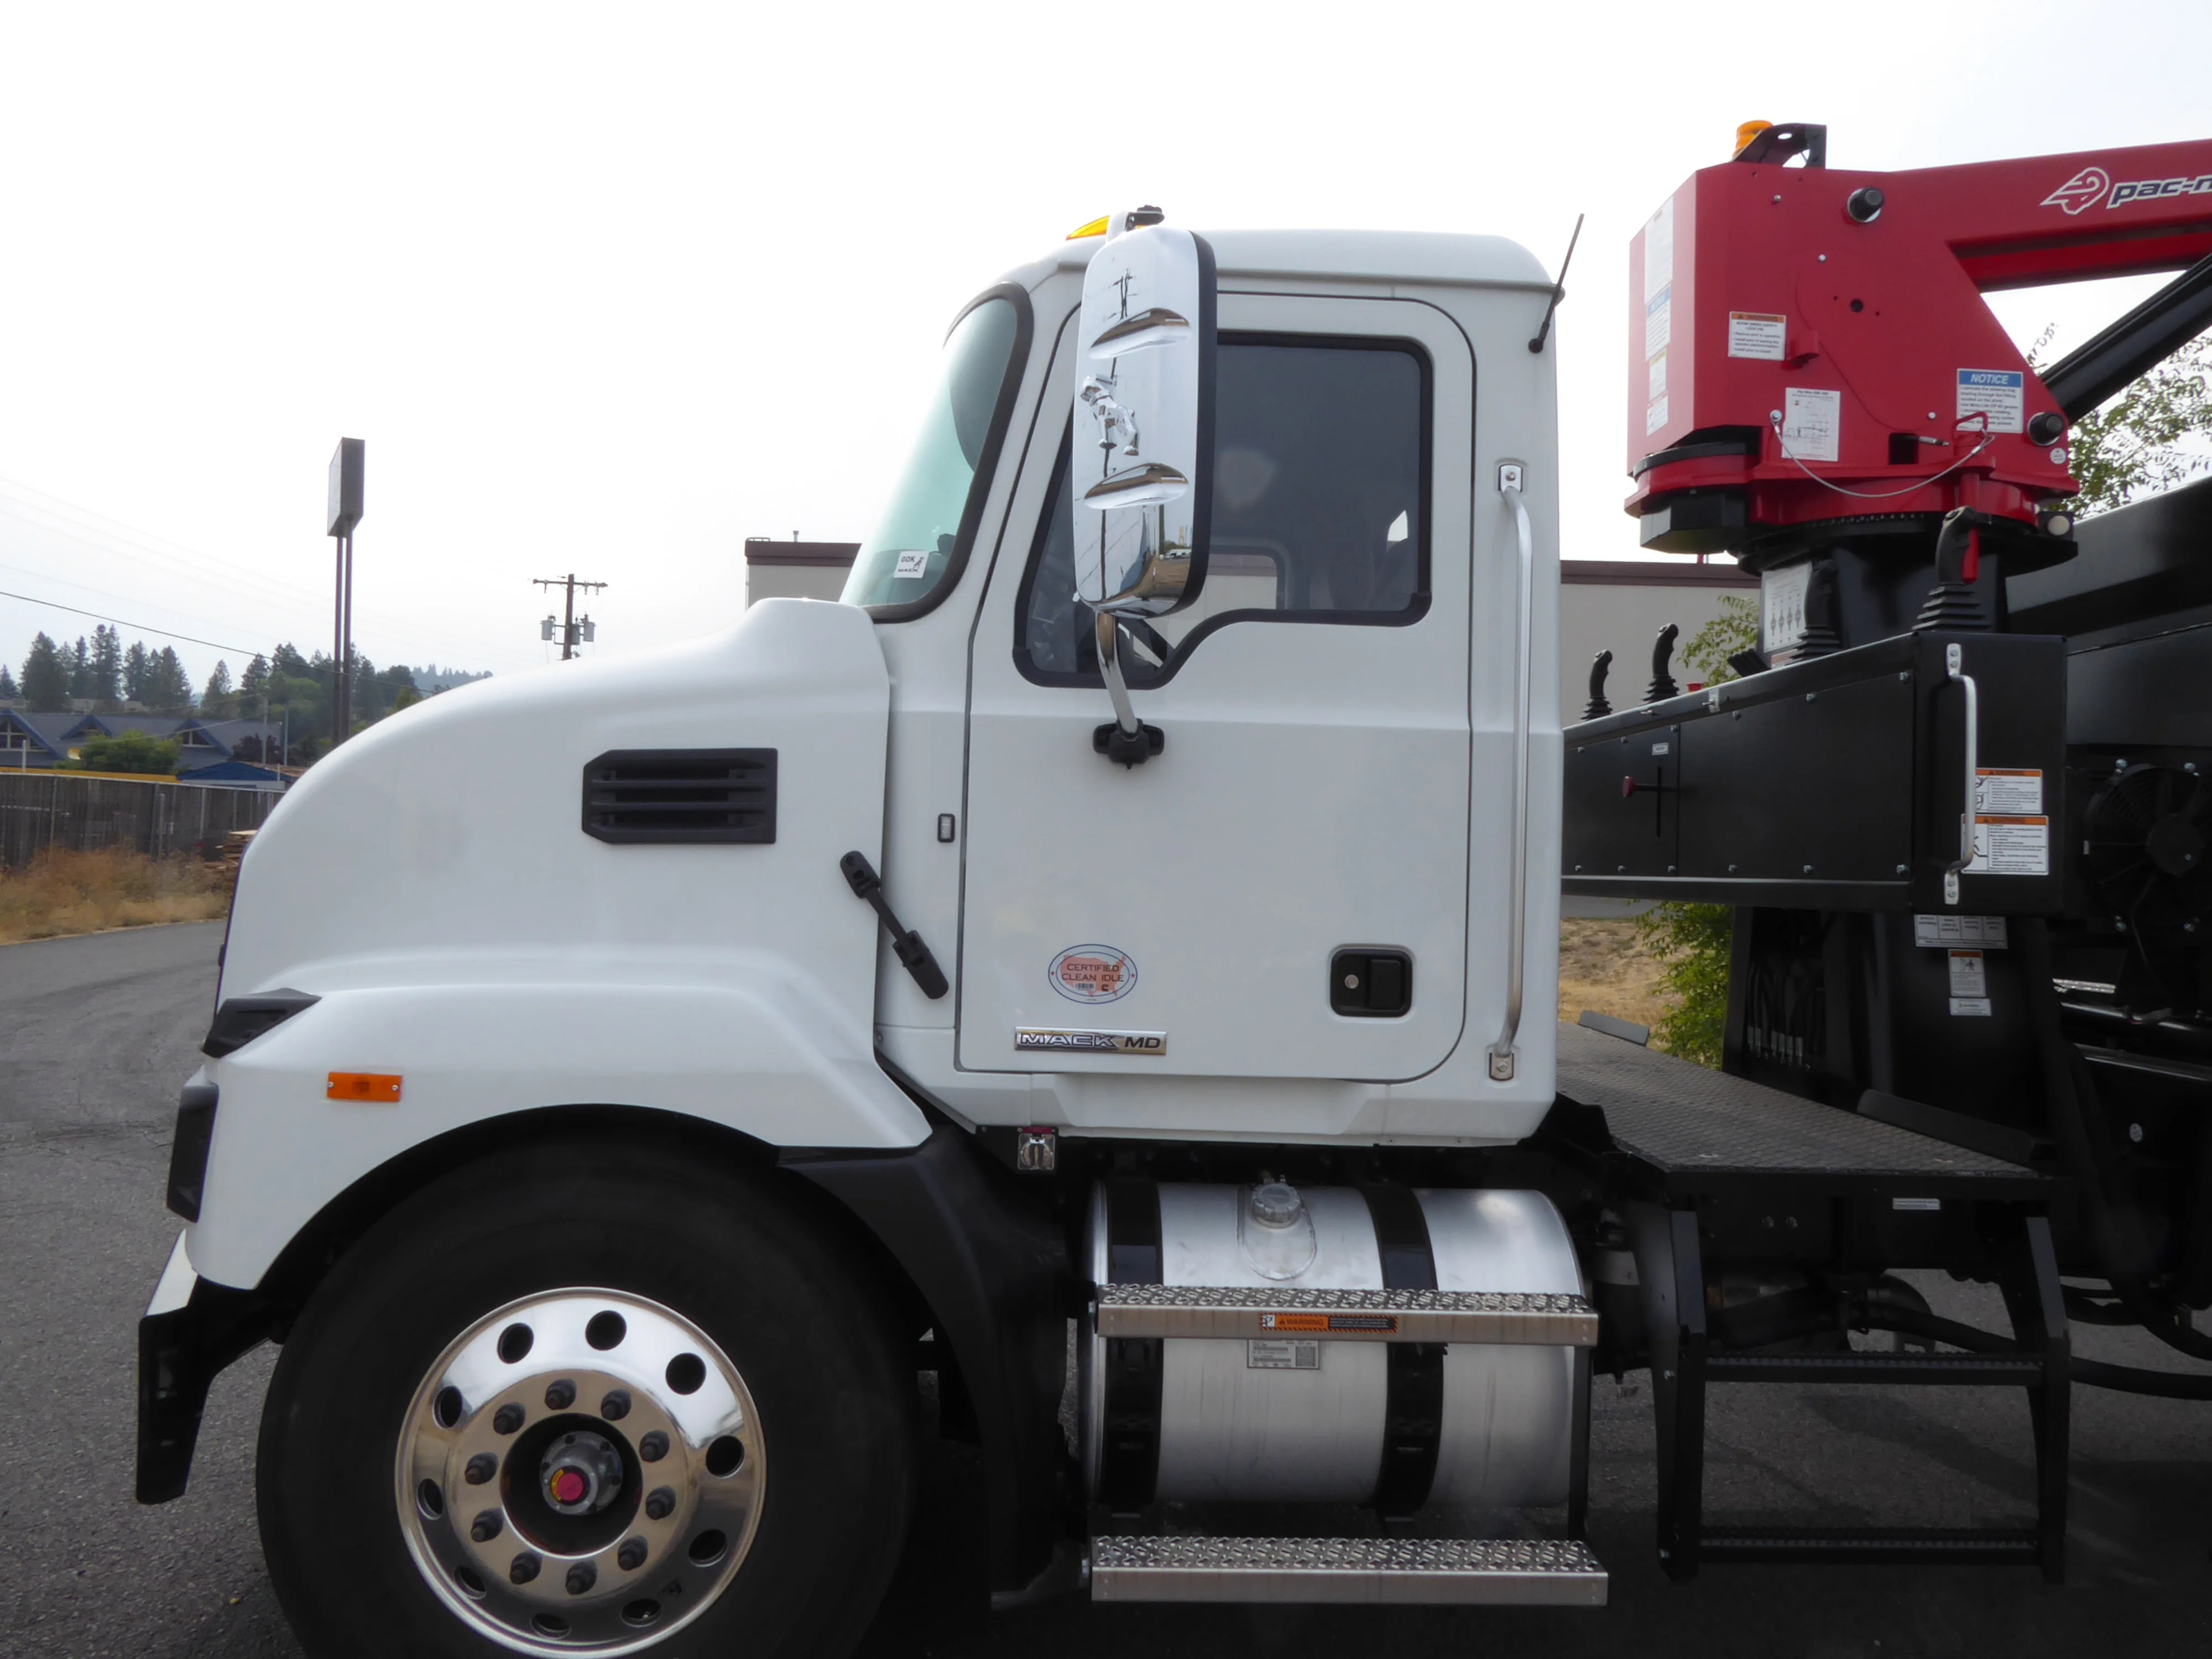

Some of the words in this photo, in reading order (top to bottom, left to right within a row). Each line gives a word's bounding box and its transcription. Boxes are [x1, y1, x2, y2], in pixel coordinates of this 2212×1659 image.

[1970, 373, 2008, 385] NOTICE
[1067, 963, 1119, 972] CERTIFIED
[1062, 973, 1096, 981] CLEAN
[1020, 1033, 1117, 1048] MACK
[1125, 1036, 1161, 1048] MD
